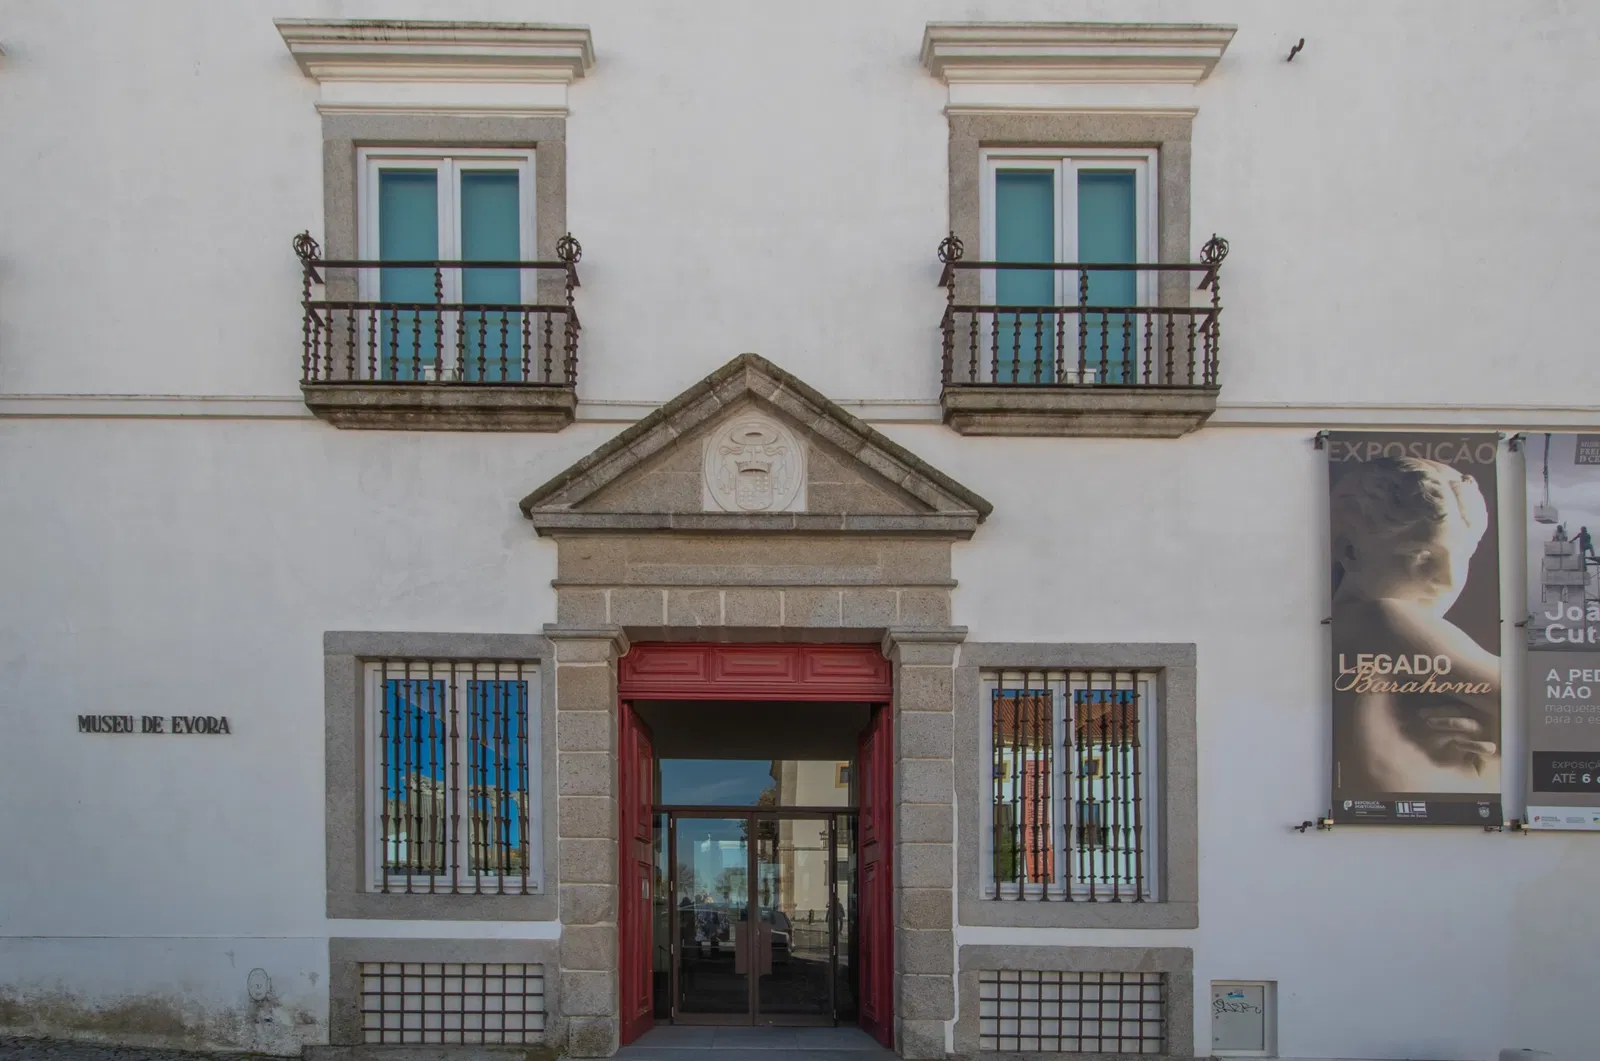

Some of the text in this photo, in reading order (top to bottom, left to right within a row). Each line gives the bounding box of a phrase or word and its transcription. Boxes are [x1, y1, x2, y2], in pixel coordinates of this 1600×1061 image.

[1339, 653, 1452, 675] LEGADO
[1334, 664, 1492, 694] Barahona
[1546, 668, 1561, 682] A
[1547, 681, 1592, 699] NÃO
[77, 715, 231, 734] MUSEU DE EVORA
[1545, 715, 1571, 725] para
[1575, 716, 1583, 724] o
[1551, 770, 1577, 784] ATÉ
[1582, 773, 1591, 784] 6
